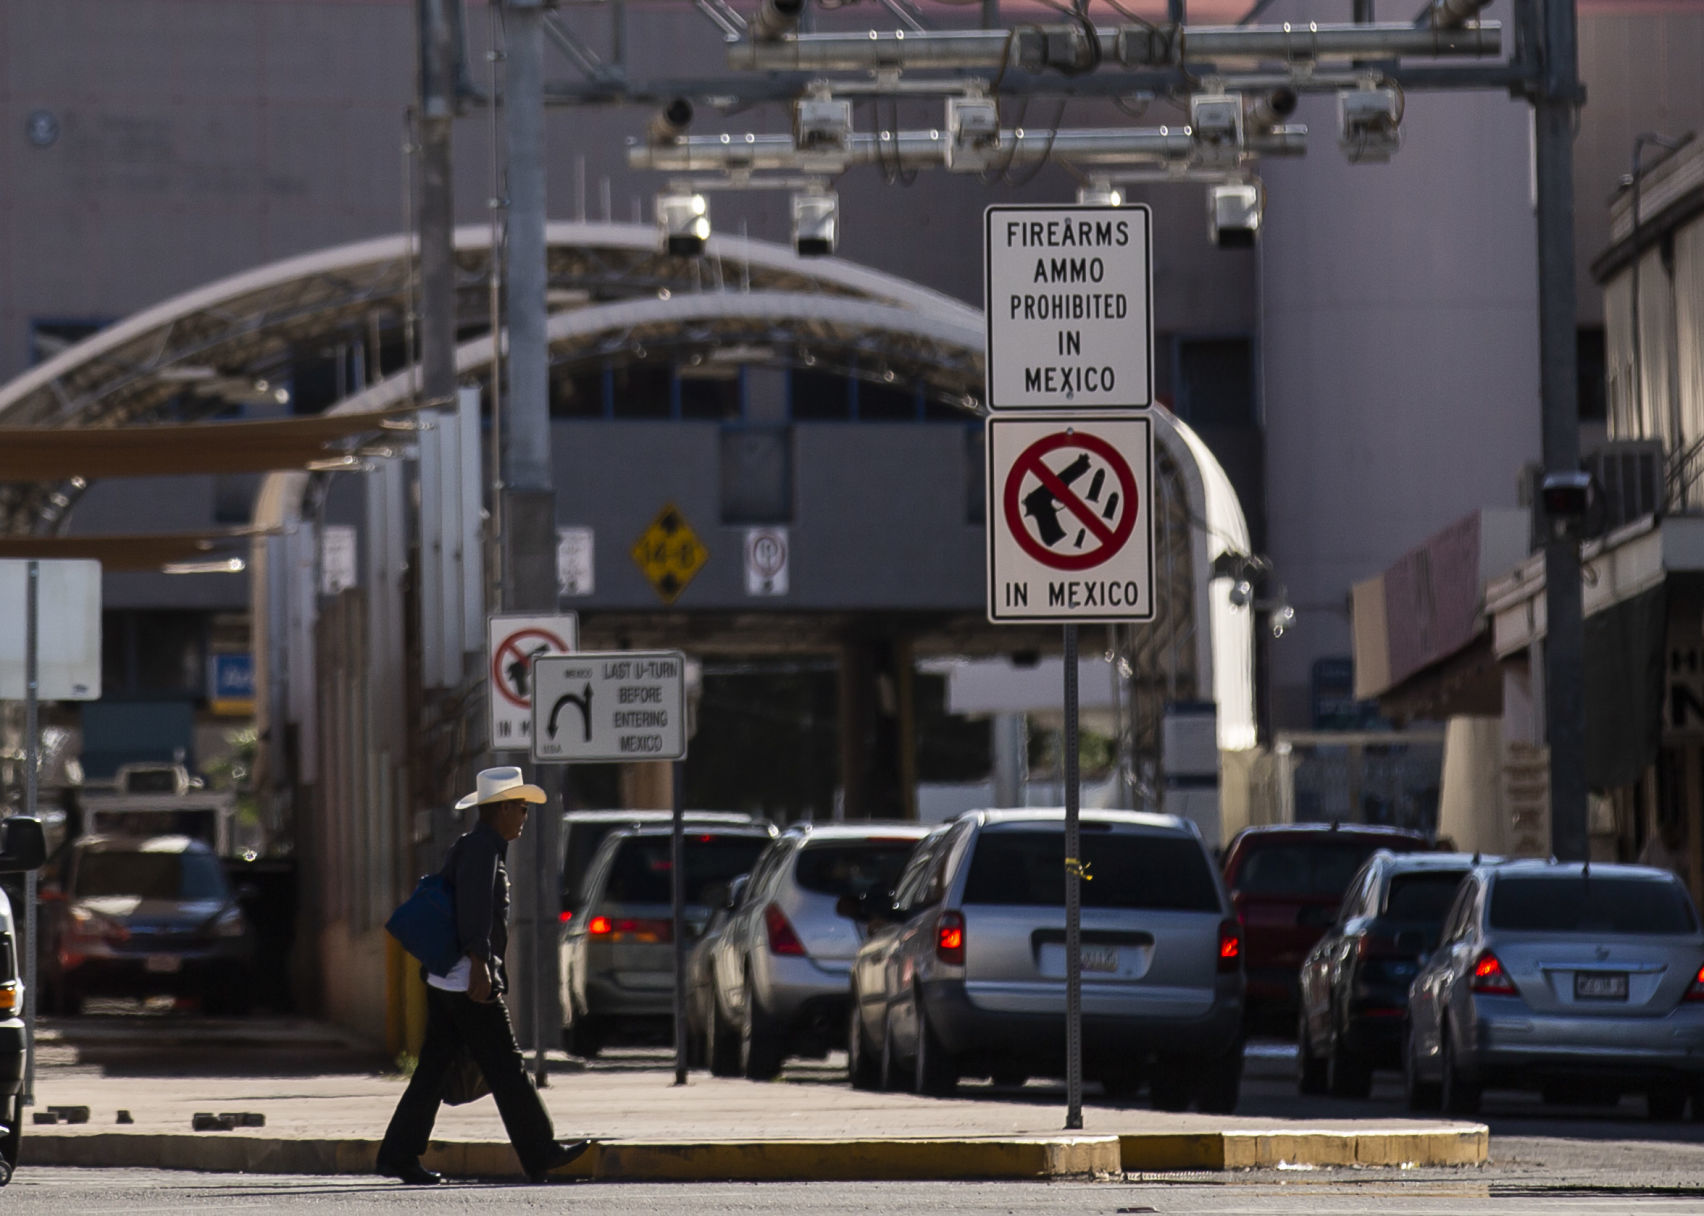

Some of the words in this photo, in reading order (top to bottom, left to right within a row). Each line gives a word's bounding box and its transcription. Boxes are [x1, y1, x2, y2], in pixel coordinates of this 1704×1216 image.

[1007, 221, 1129, 247] FIREARMS
[1034, 257, 1104, 284] AMMO
[1010, 293, 1127, 320] PROHIBITED
[1058, 330, 1081, 356] IN
[1025, 366, 1115, 392] MEXICO
[1005, 582, 1028, 607] IN
[1048, 581, 1139, 607] MEXICO
[564, 667, 593, 679] MEXICO
[602, 661, 632, 680] LAST
[636, 661, 678, 679] U-TURN
[617, 685, 663, 704] BEFORE
[497, 720, 512, 737] IN
[613, 710, 669, 729] ENTERING
[619, 734, 663, 753] MEXICO
